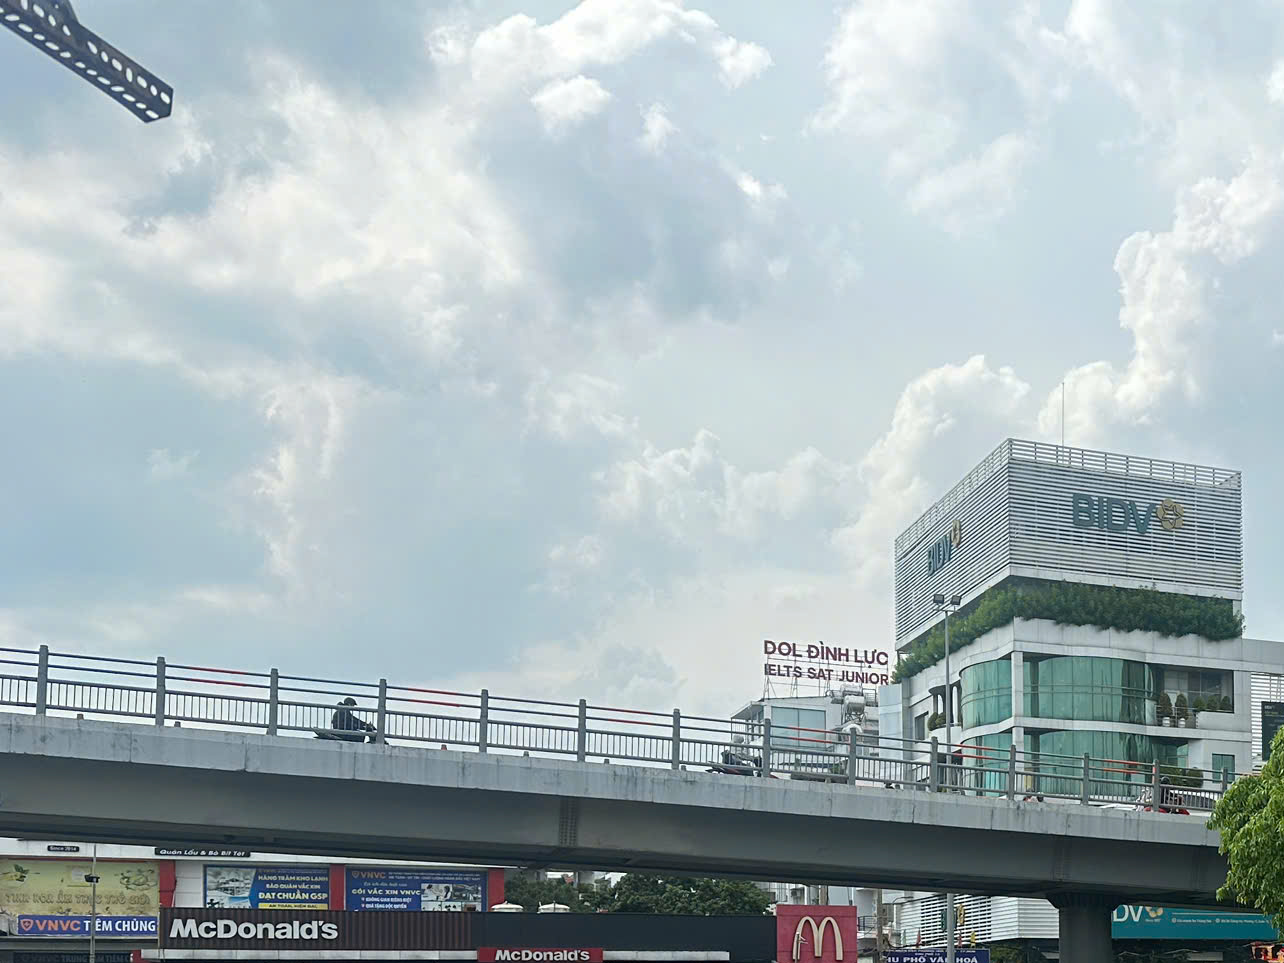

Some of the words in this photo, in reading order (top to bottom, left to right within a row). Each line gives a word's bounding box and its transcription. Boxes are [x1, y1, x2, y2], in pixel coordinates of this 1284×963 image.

[1072, 492, 1157, 534] BIDV
[927, 532, 951, 577] BIDV
[763, 639, 803, 657] DOL
[806, 640, 850, 662] ĐÌNH
[854, 648, 889, 668] LỰC
[764, 663, 802, 678] IELTS
[807, 667, 834, 681] SAT
[839, 670, 889, 685] JUNIOR
[360, 871, 386, 879] VNVC
[258, 892, 277, 901] ĐẠT
[277, 889, 310, 899] CHUẨN
[1112, 904, 1143, 922] DV
[36, 919, 81, 931] VNVC
[83, 918, 113, 931] TÊM
[115, 918, 156, 932] CHỦNG
[169, 918, 339, 939] McDonald's
[495, 949, 590, 961] McDonald's
[903, 955, 926, 963] PHỐ
[956, 955, 978, 963] HOÁ
